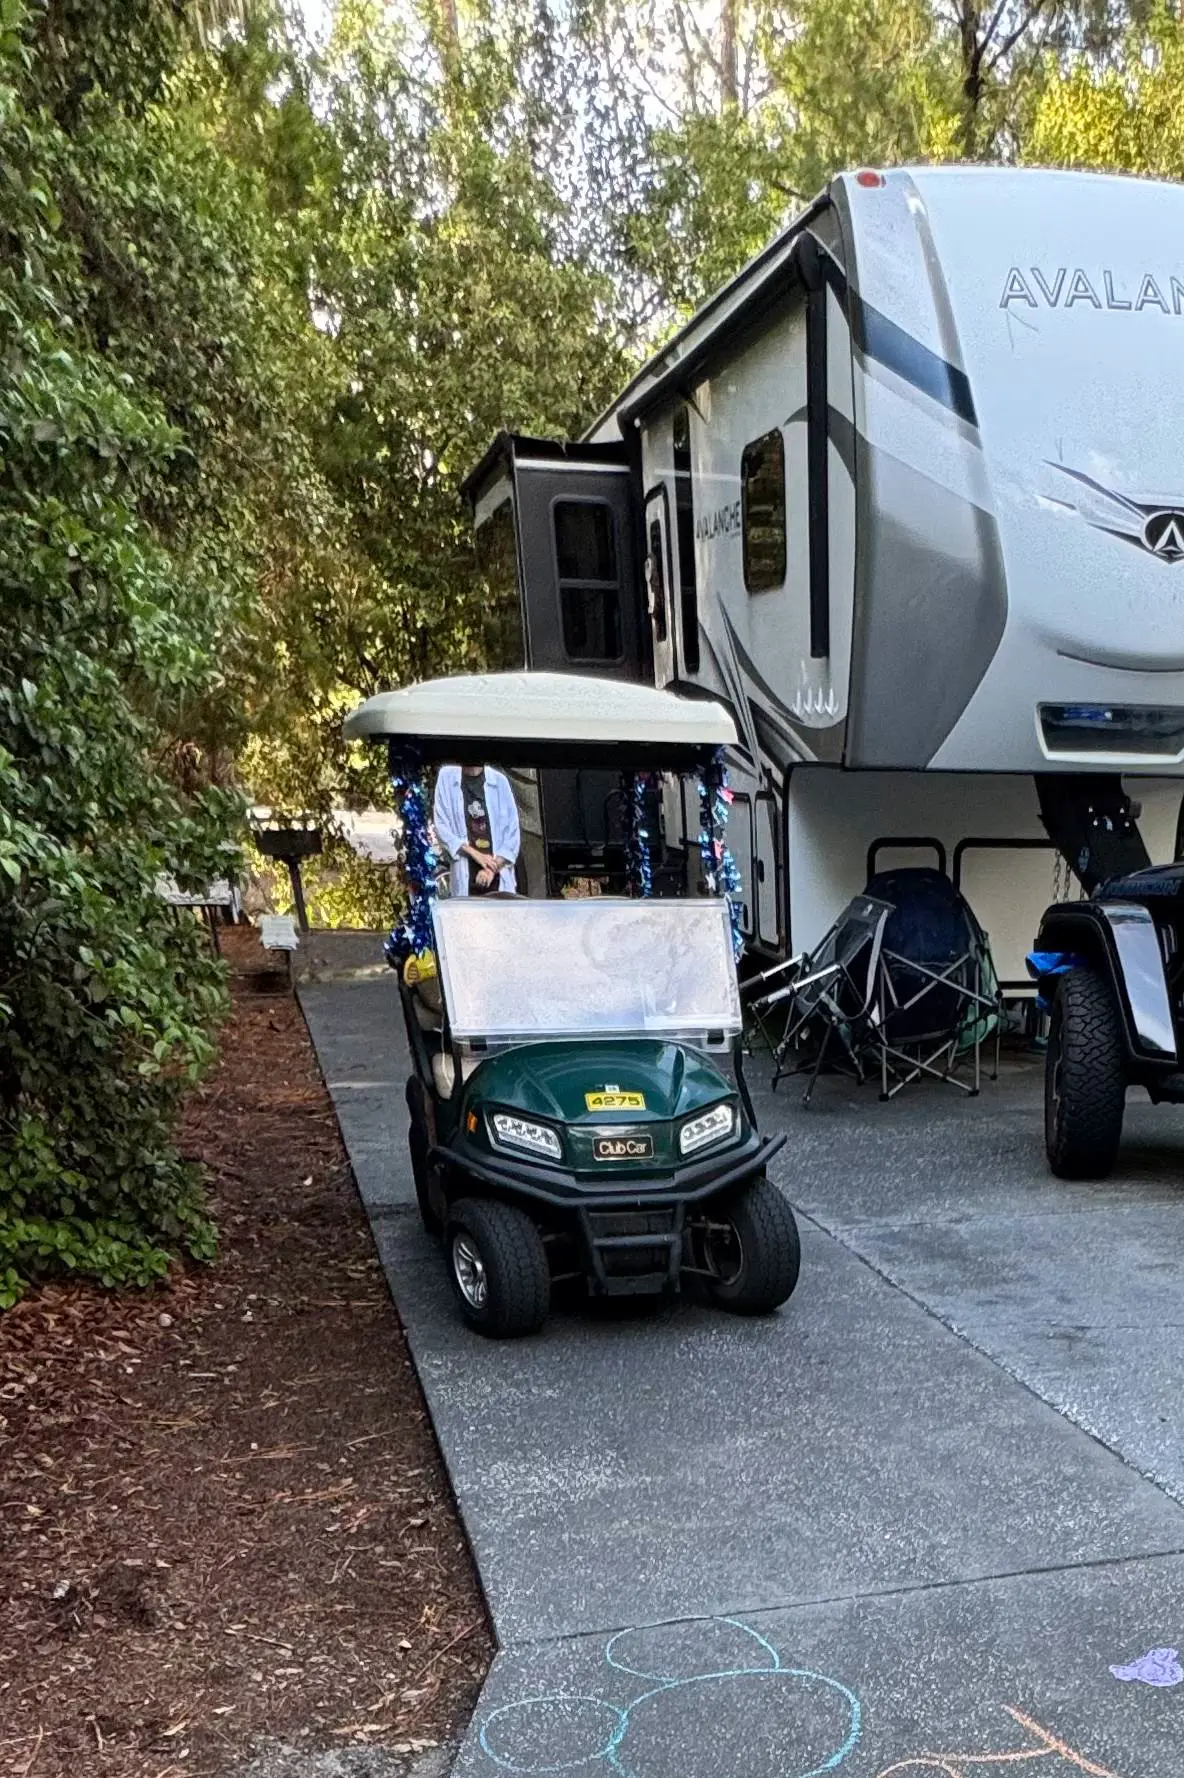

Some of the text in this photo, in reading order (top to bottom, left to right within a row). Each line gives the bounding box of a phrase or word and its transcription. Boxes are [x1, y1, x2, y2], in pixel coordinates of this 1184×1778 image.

[591, 1096, 641, 1106] 4275
[599, 1140, 647, 1155] Club Car
